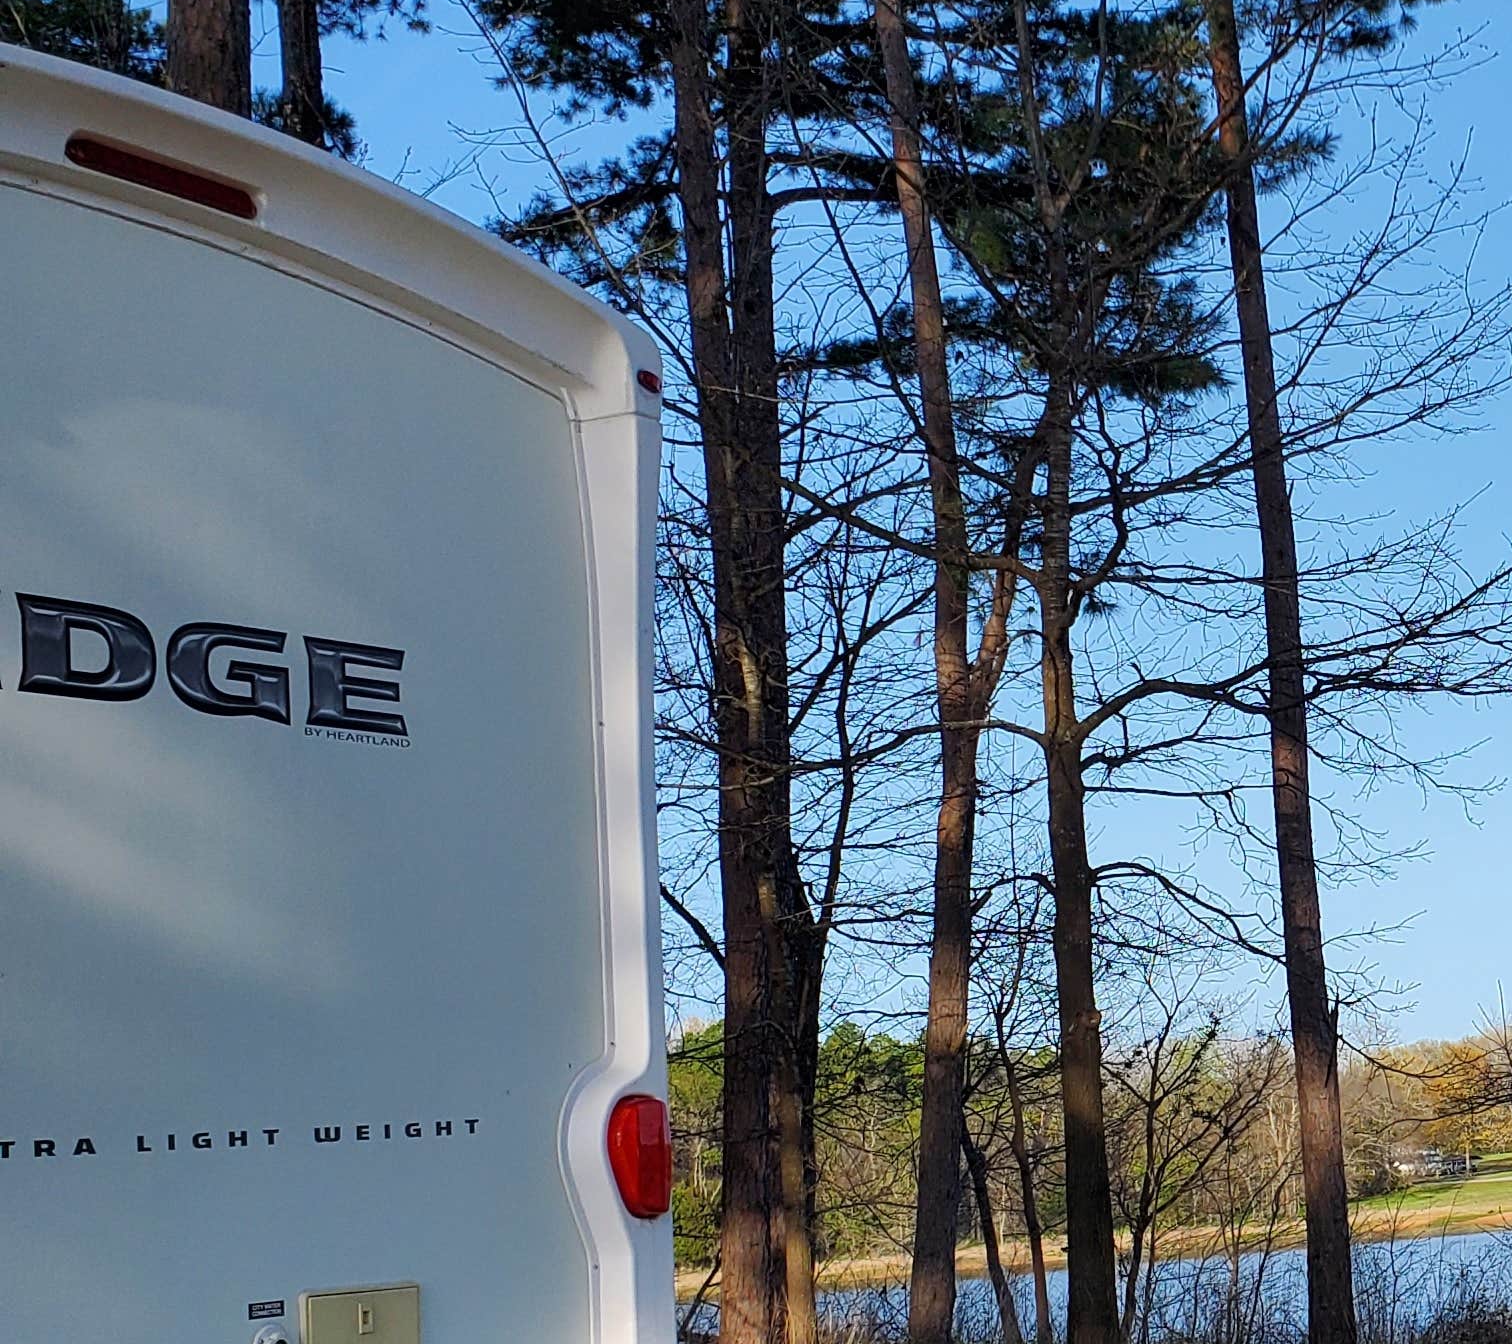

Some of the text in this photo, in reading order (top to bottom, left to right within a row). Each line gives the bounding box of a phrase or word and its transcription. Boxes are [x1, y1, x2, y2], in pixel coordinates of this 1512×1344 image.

[0, 591, 408, 736] DGE
[304, 727, 411, 749] BY HEARTLAND
[0, 1118, 480, 1158] TRA LIGHT WEIGHT
